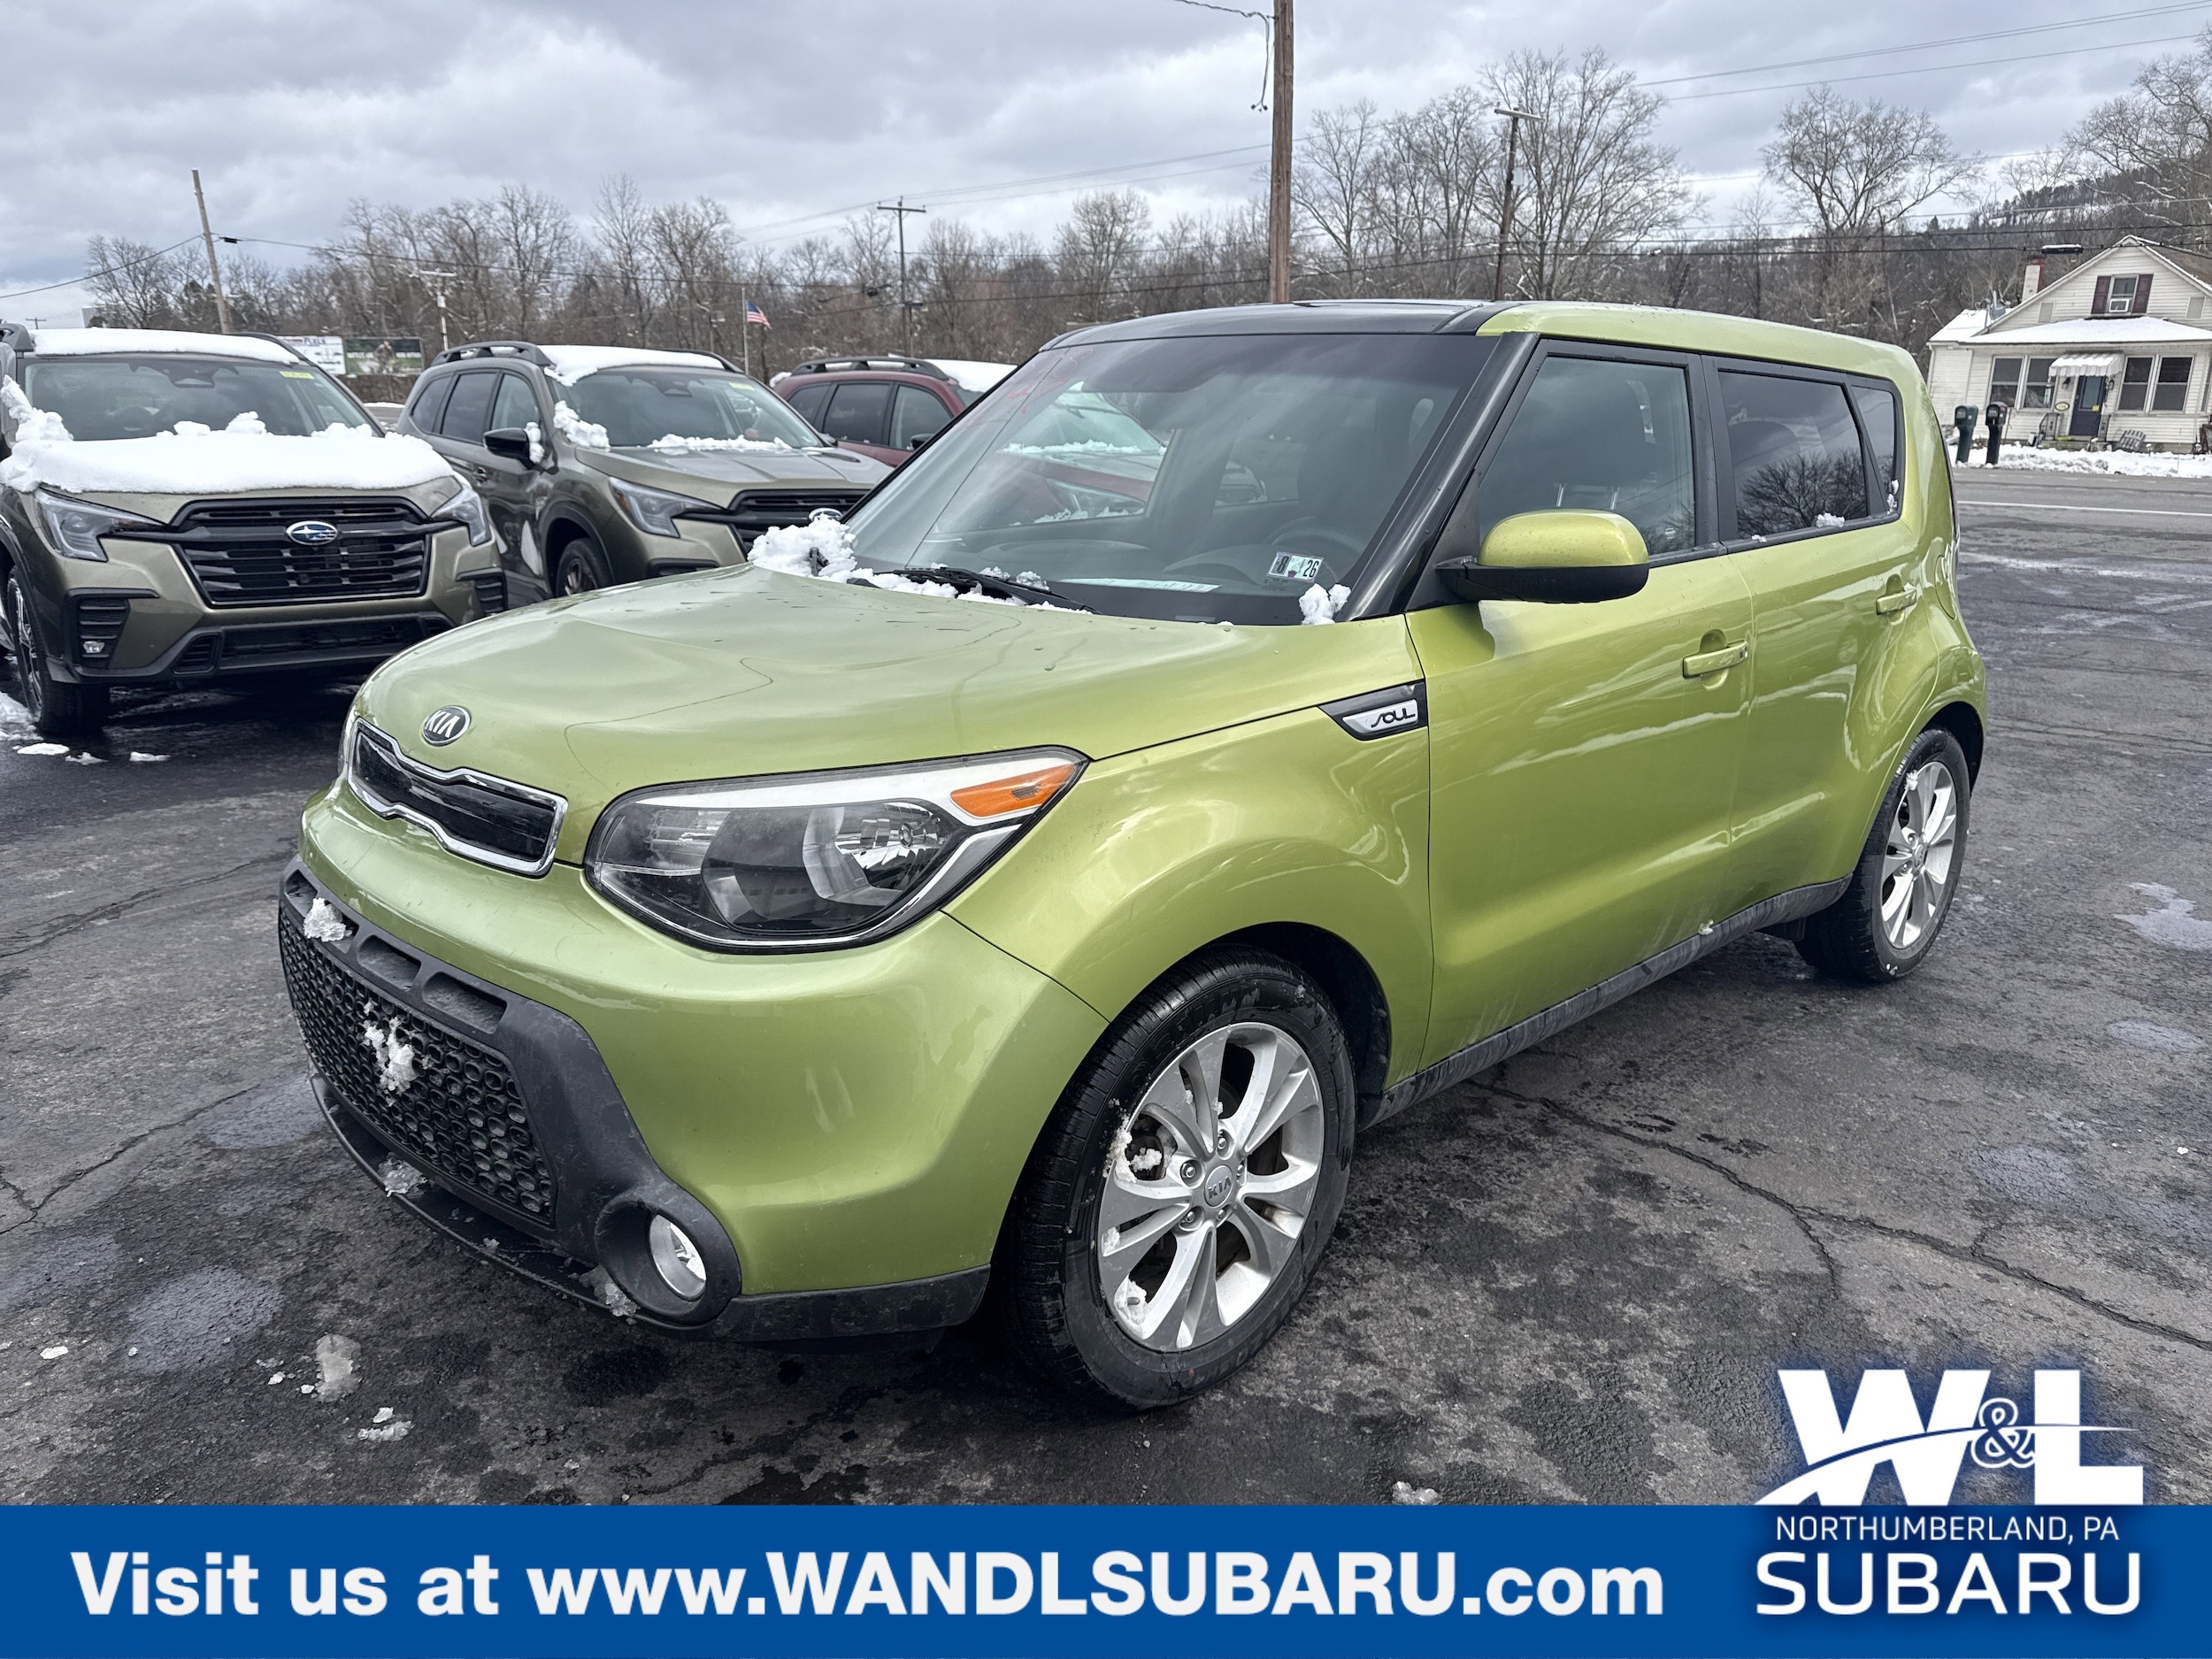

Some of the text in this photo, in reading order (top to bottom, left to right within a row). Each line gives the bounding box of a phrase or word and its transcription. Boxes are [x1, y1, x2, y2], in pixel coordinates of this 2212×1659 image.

[1302, 559, 1319, 578] 26
[424, 710, 461, 738] KIA
[1208, 1175, 1232, 1199] KIA
